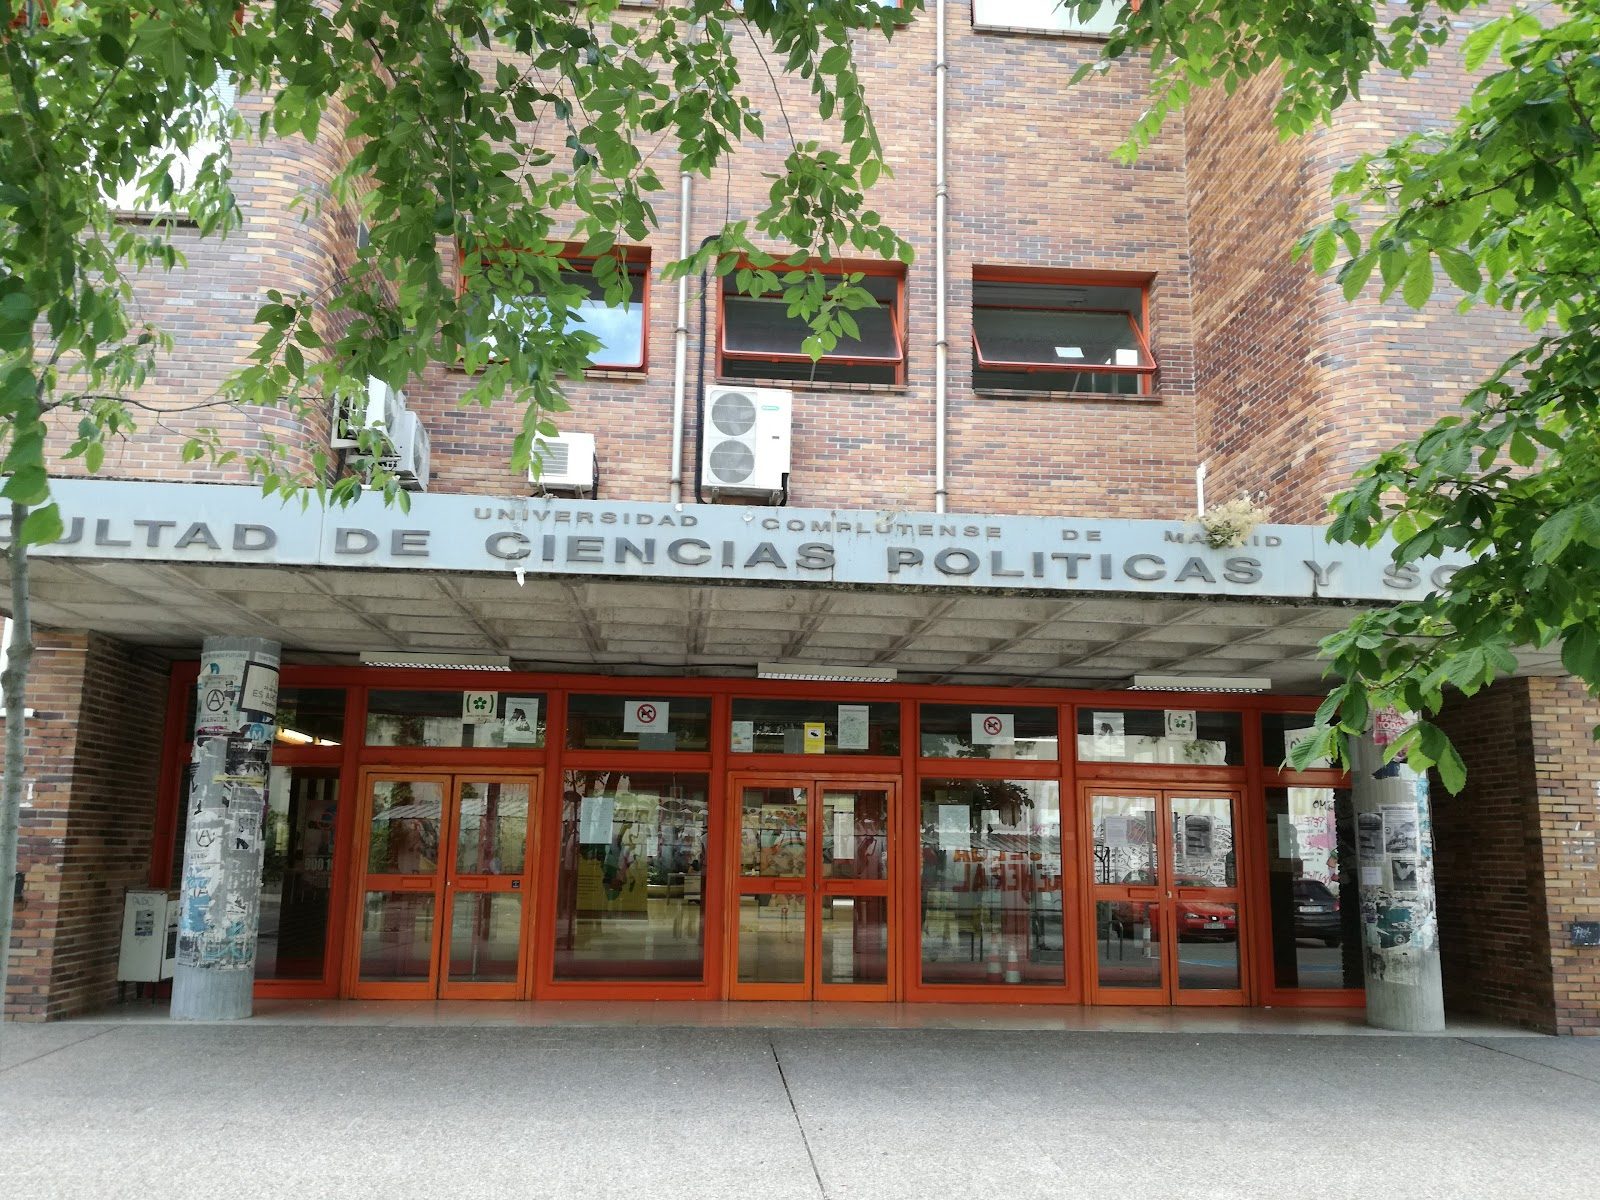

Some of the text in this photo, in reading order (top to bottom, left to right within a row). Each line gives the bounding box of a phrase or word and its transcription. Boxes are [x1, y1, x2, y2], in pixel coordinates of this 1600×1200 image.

[474, 507, 1282, 547] UNIVERSIDAD COMPLUTENSE DE MAID
[335, 527, 431, 556] DE
[485, 531, 837, 571] CIENCIAS
[887, 546, 1264, 584] POLITICAS
[1303, 560, 1343, 587] Y
